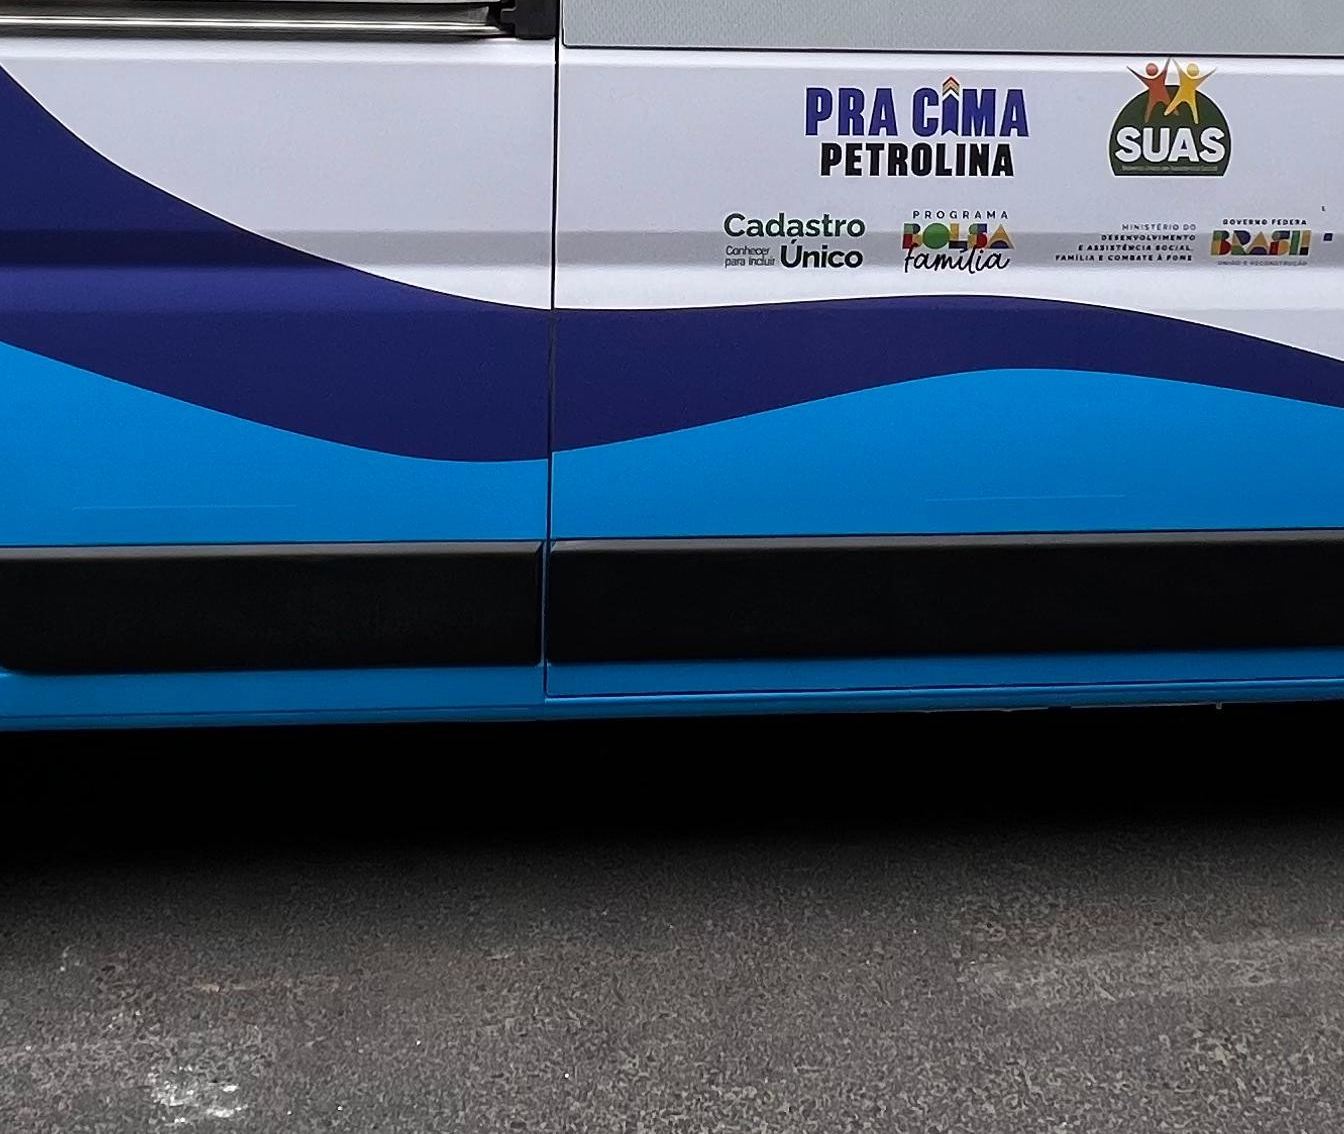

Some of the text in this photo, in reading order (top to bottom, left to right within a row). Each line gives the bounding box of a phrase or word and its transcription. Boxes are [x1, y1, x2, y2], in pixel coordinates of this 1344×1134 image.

[805, 77, 1030, 137] PRA CIMA
[1114, 126, 1226, 163] SUAS
[820, 141, 1015, 177] PETROLINA
[723, 212, 866, 238] Cadastro
[912, 210, 1009, 220] PROGRAMA
[1121, 223, 1197, 231] MINISTÉRIO DO
[902, 222, 1015, 249] BOLSA
[1086, 243, 1152, 251] ASSISTÊNCIA
[780, 237, 864, 269] Único
[904, 243, 1011, 274] família
[1055, 253, 1095, 261] FAMÍLIA
